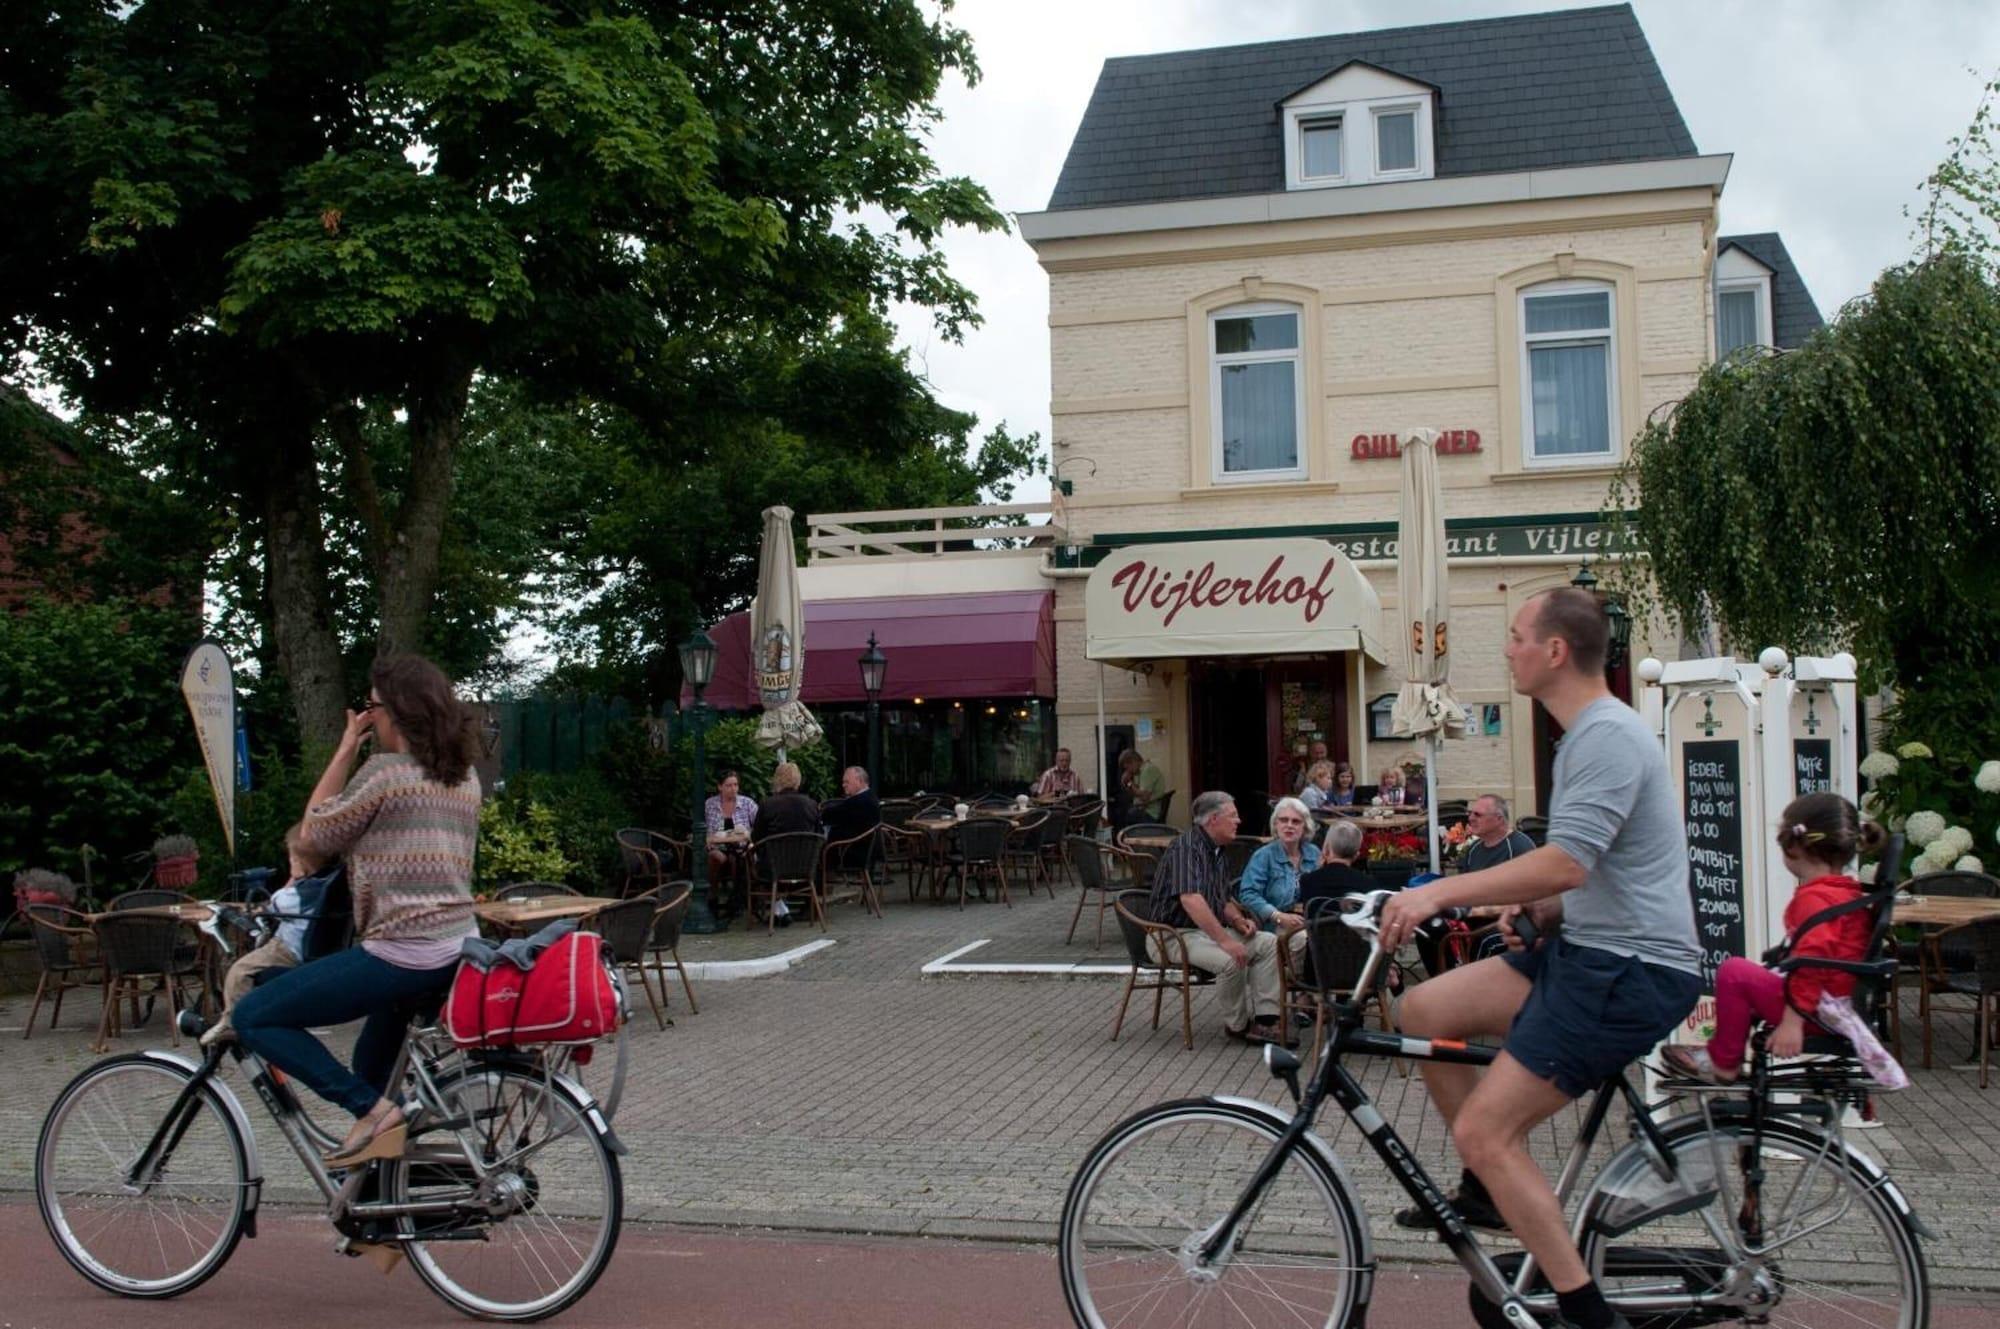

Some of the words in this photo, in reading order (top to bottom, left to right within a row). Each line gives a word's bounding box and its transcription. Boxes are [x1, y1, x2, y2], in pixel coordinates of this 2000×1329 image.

[1351, 430, 1482, 458] GULNER
[1335, 532, 1497, 558] estaant
[1111, 555, 1334, 628] Vijlerhof
[1705, 923, 1728, 937] TOT
